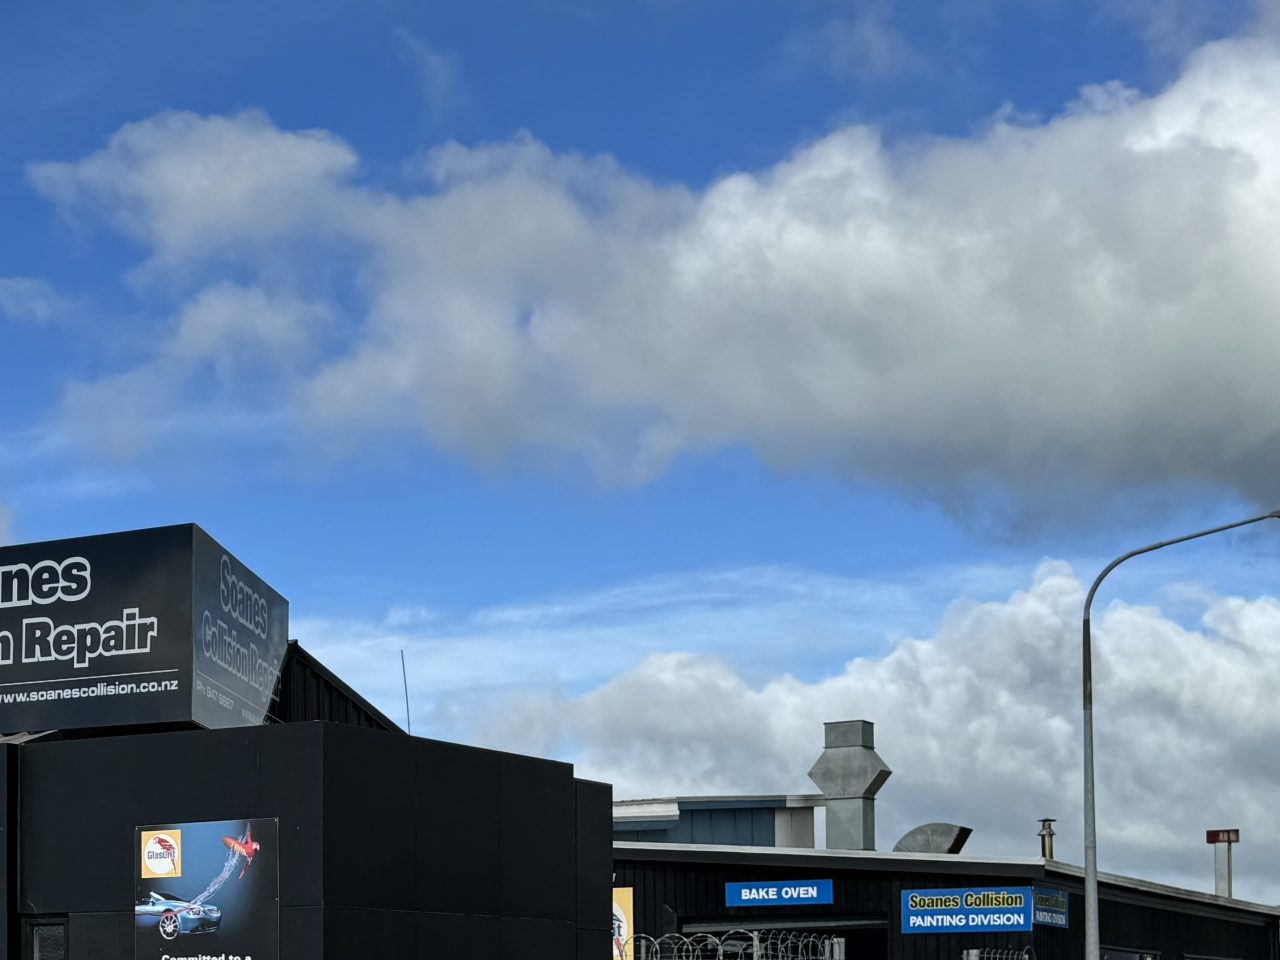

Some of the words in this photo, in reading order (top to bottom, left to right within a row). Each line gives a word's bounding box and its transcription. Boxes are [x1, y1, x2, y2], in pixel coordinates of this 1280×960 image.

[220, 554, 268, 639] Soanes
[22, 608, 158, 668] Repair
[202, 610, 248, 683] Collision
[250, 642, 282, 702] Repair
[741, 888, 777, 900] BAKE
[781, 886, 817, 899] OVEN
[909, 894, 960, 910] Soanes
[964, 892, 1023, 908] Collision
[909, 915, 966, 927] PAINTING
[969, 914, 1024, 926] DIVISION
